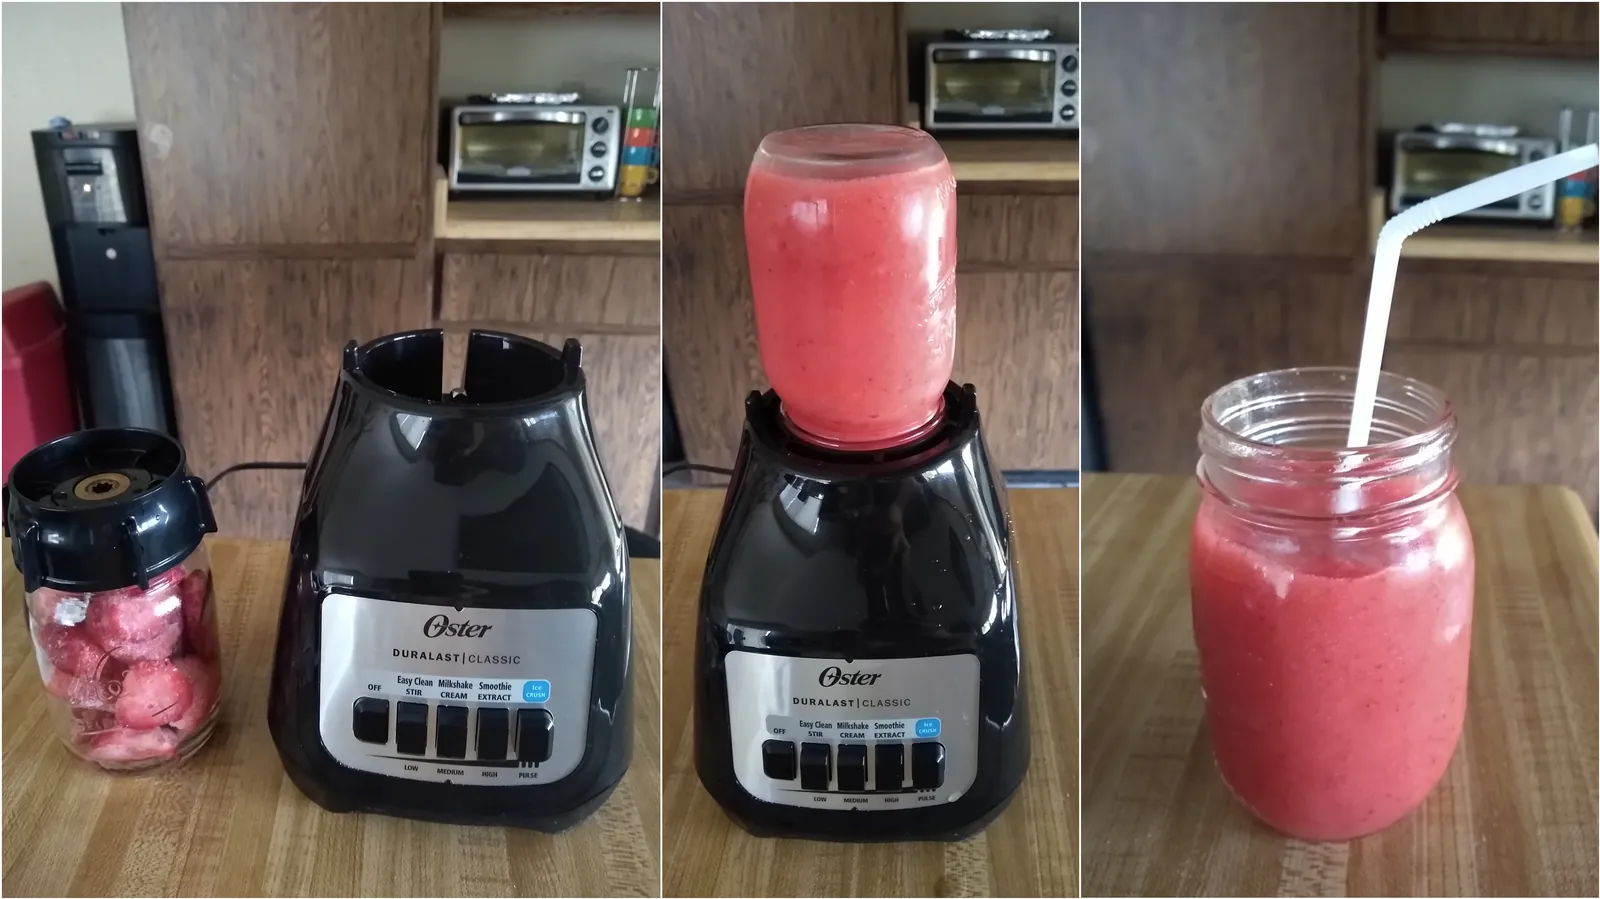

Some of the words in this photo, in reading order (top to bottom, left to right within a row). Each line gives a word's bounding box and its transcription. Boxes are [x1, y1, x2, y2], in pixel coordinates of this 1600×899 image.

[423, 614, 492, 638] Oster
[393, 648, 460, 663] DURALAST
[468, 654, 521, 665] CLASSIC
[397, 675, 413, 687] Easy
[414, 676, 433, 687] Clean
[818, 666, 882, 688] Oster
[367, 684, 382, 692] OFF
[438, 678, 473, 690] Milkshake
[479, 681, 512, 692] Smoothie
[405, 688, 422, 697] STIR
[440, 691, 468, 700] CREAM
[477, 693, 511, 701] EXTRACT
[793, 697, 854, 708] DURALAST
[862, 698, 911, 708] CLASSIC
[799, 720, 813, 730] Easy
[814, 720, 833, 729] Clean
[836, 721, 869, 730] Milkshake
[874, 721, 905, 730] Smoothie
[808, 730, 823, 738] STIR
[839, 731, 865, 739] CREAM
[874, 731, 905, 739] EXTRACT
[404, 764, 419, 772] LOW
[436, 768, 465, 776] MEDIUM
